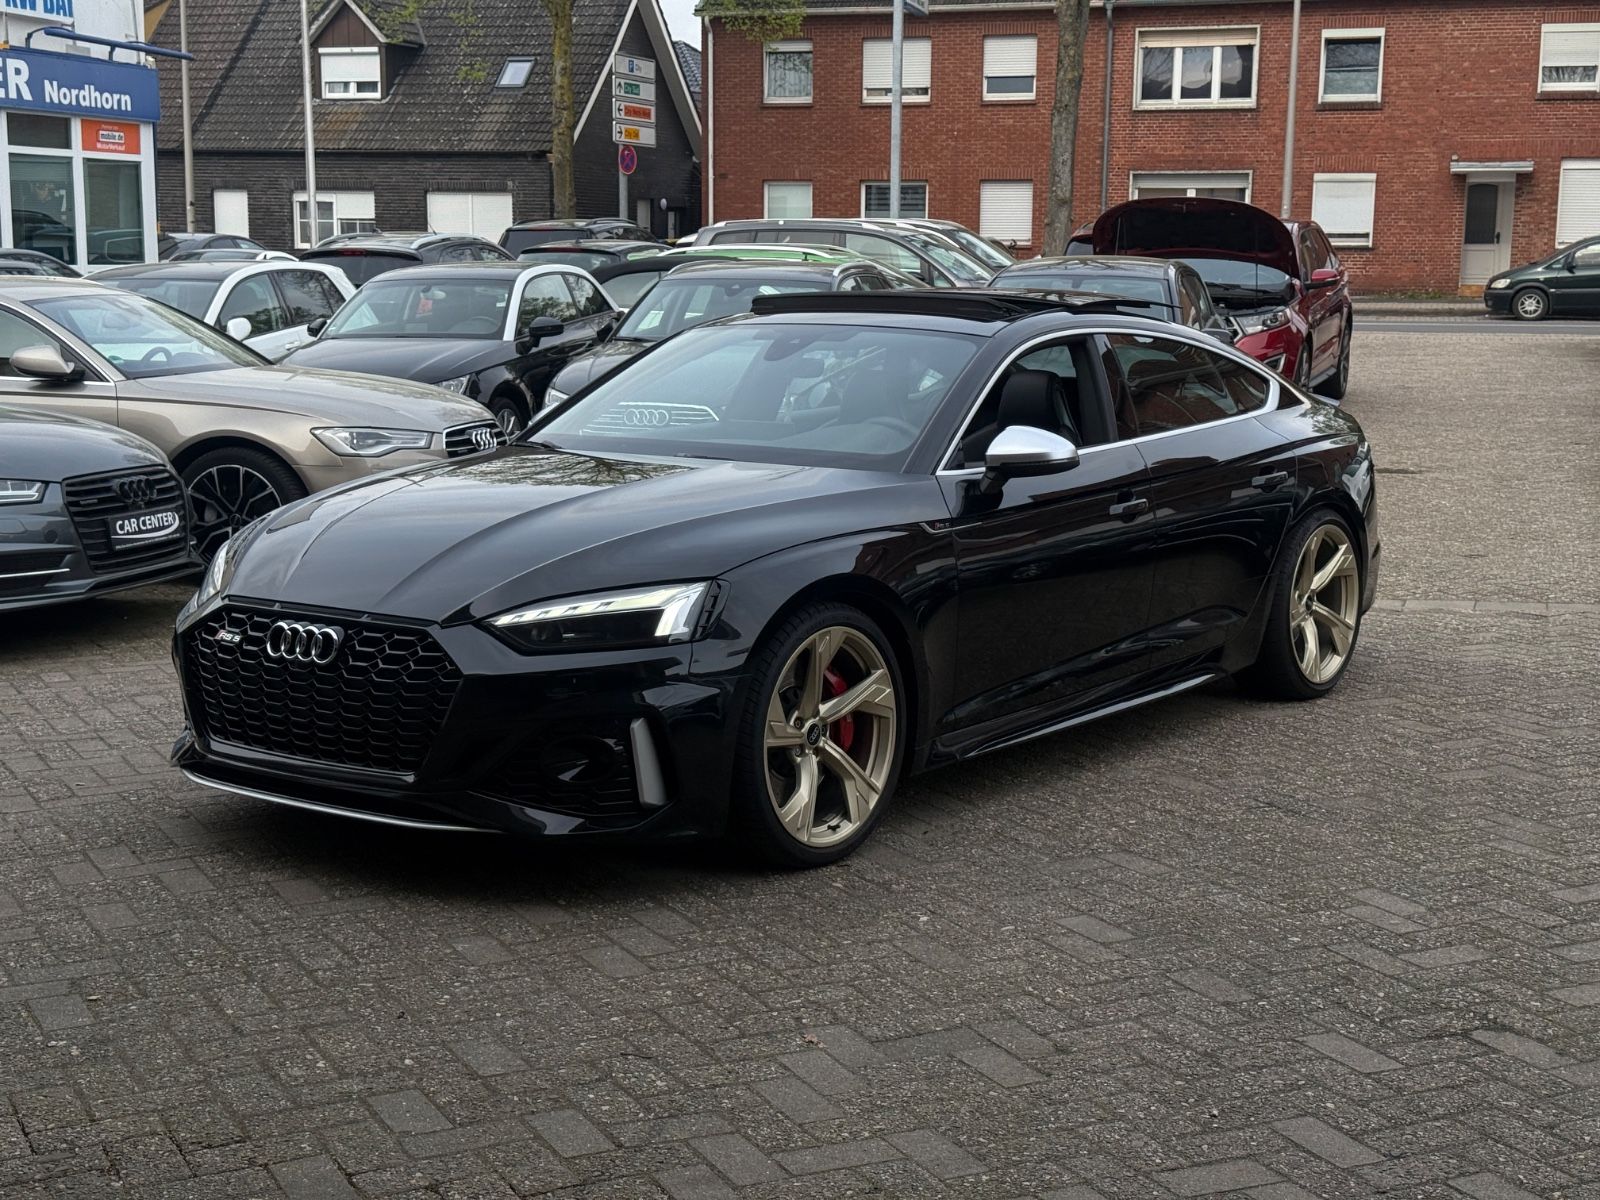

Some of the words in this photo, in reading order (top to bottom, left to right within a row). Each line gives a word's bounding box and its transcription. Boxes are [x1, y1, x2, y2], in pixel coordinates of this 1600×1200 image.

[44, 79, 132, 112] Nordhorn
[116, 518, 139, 534] CAR
[139, 512, 174, 530] CENTER
